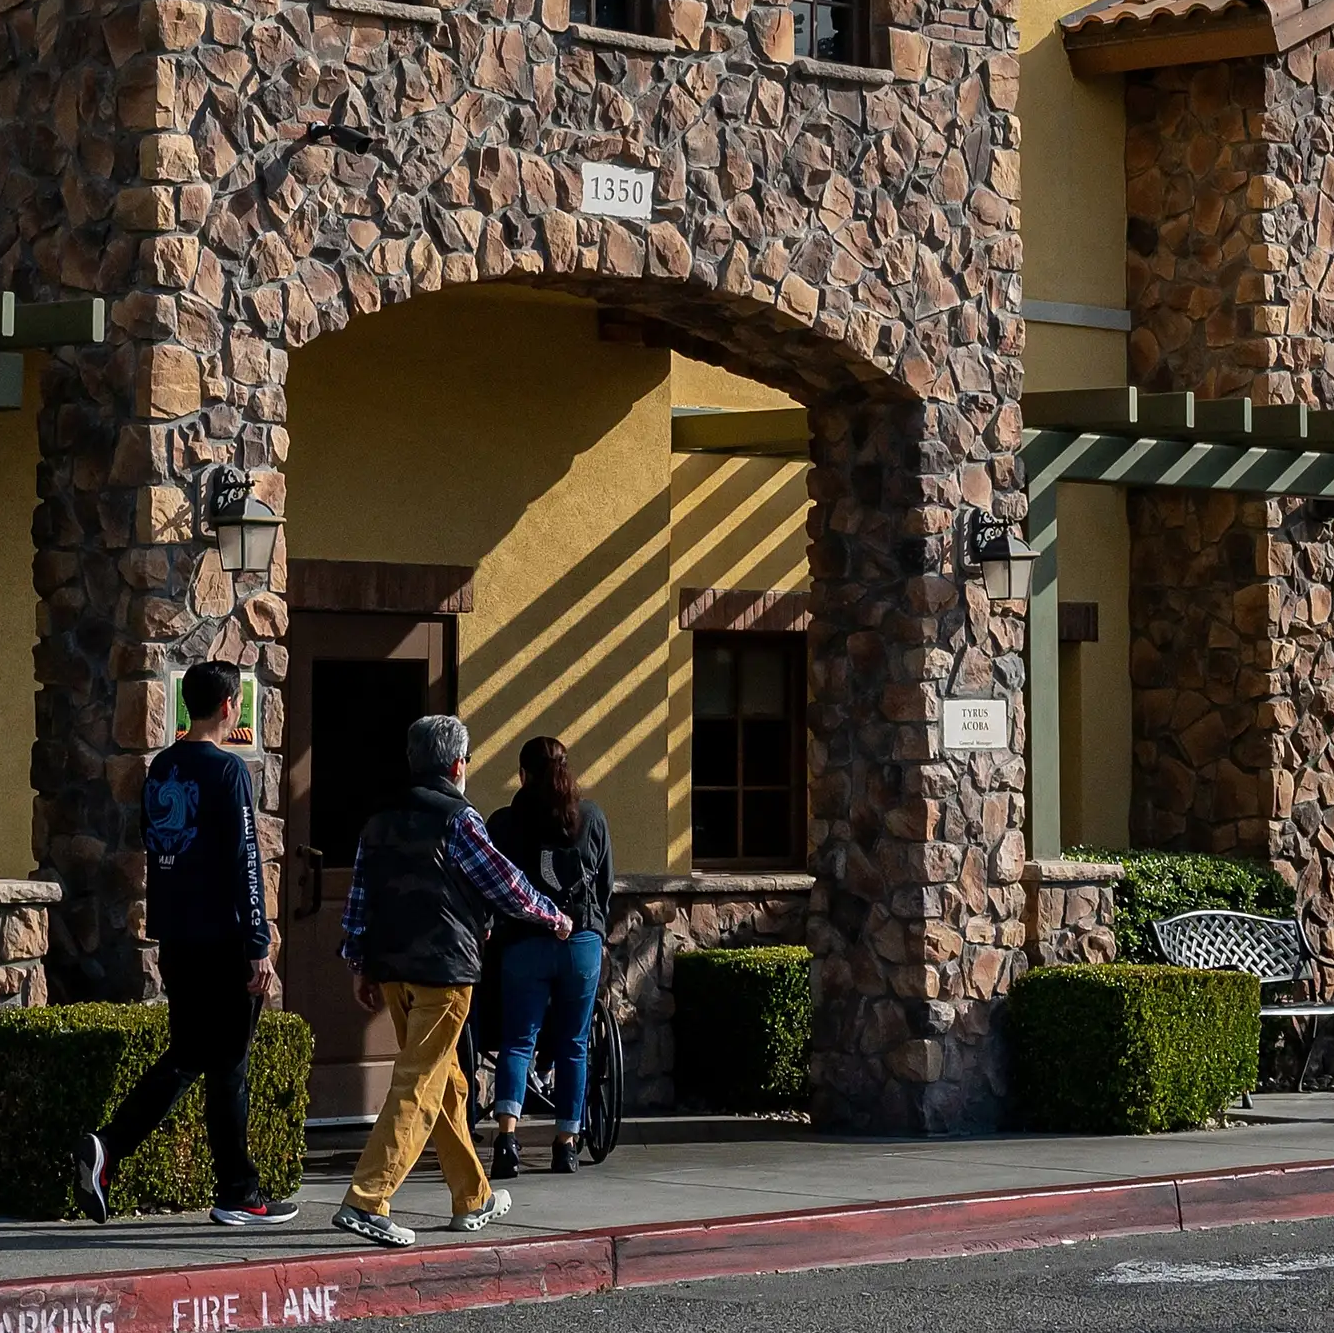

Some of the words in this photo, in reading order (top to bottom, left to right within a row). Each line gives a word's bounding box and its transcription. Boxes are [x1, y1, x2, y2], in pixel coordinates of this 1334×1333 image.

[590, 176, 644, 205] 1350
[961, 708, 989, 718] TYRUS
[961, 721, 990, 731] ACOBA
[242, 806, 255, 840] MAUI
[246, 843, 259, 905] BREWING
[172, 1292, 240, 1332] FIRE
[261, 1285, 340, 1326] LANE
